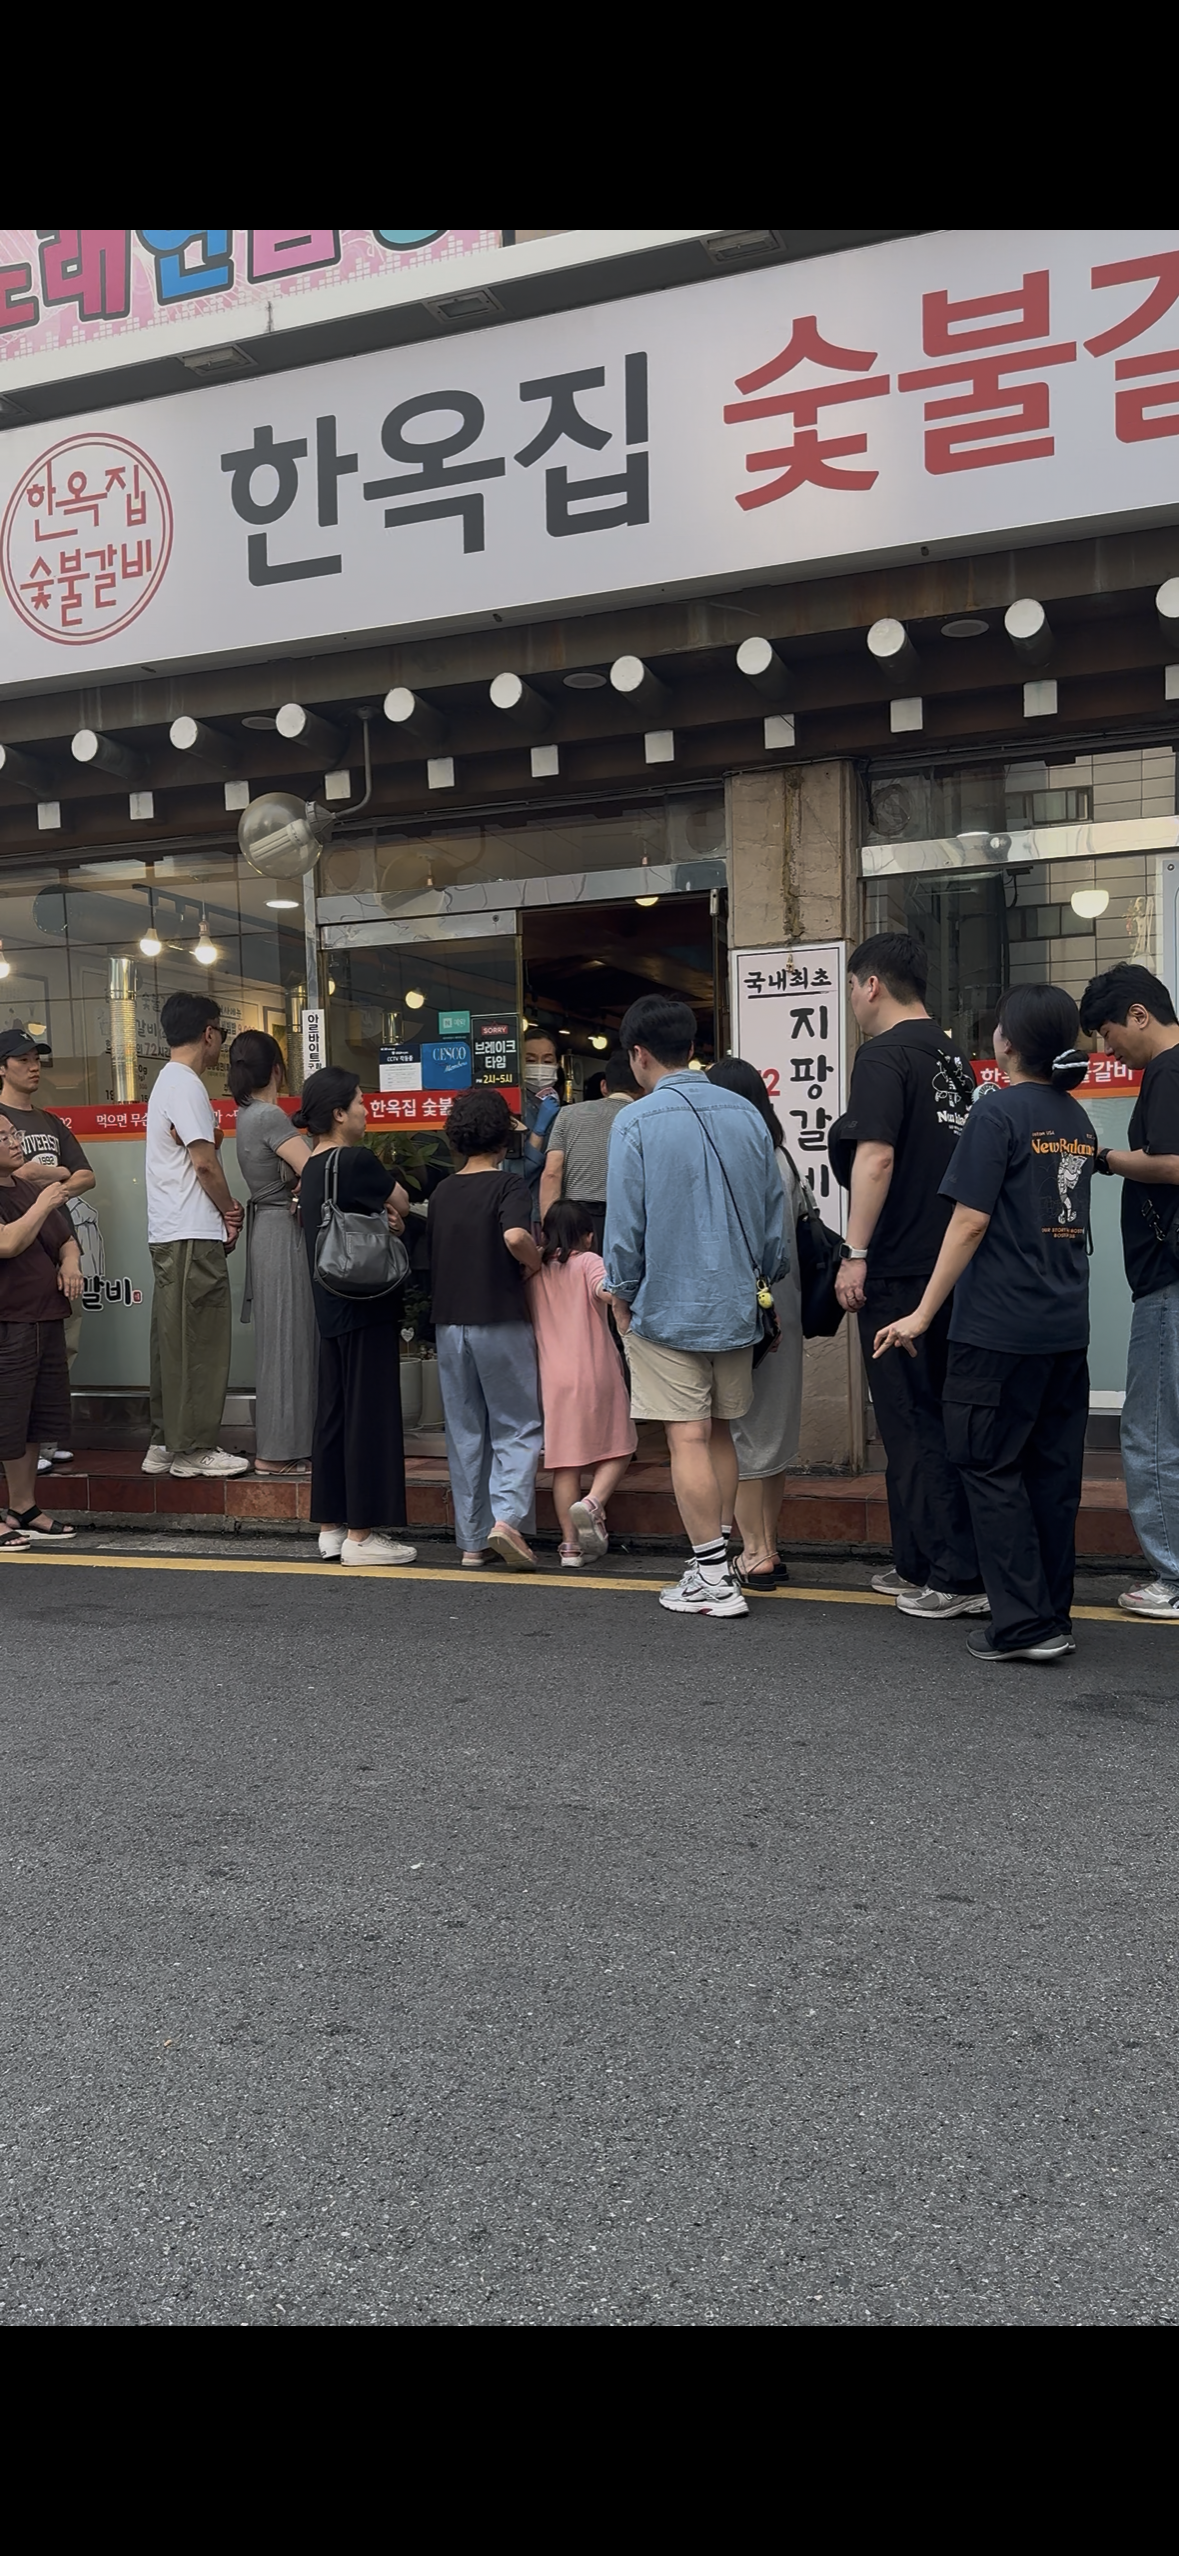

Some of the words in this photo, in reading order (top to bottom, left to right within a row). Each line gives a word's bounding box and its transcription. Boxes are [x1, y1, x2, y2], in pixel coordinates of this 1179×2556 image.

[220, 351, 650, 588] 한옥집
[25, 462, 148, 542] 한옥집
[20, 540, 153, 627] 숯불갈비
[743, 967, 833, 994] 국내최초
[307, 1014, 321, 1063] 아르바이트
[483, 1026, 507, 1034] SORRY
[432, 1046, 467, 1061] CESCO
[474, 1040, 517, 1055] 브레이크
[485, 1056, 507, 1069] 타임
[483, 1074, 513, 1084] 2시~5시
[758, 1068, 781, 1097] 2
[370, 1098, 417, 1118] 한옥집
[96, 1113, 128, 1128] 먹으면
